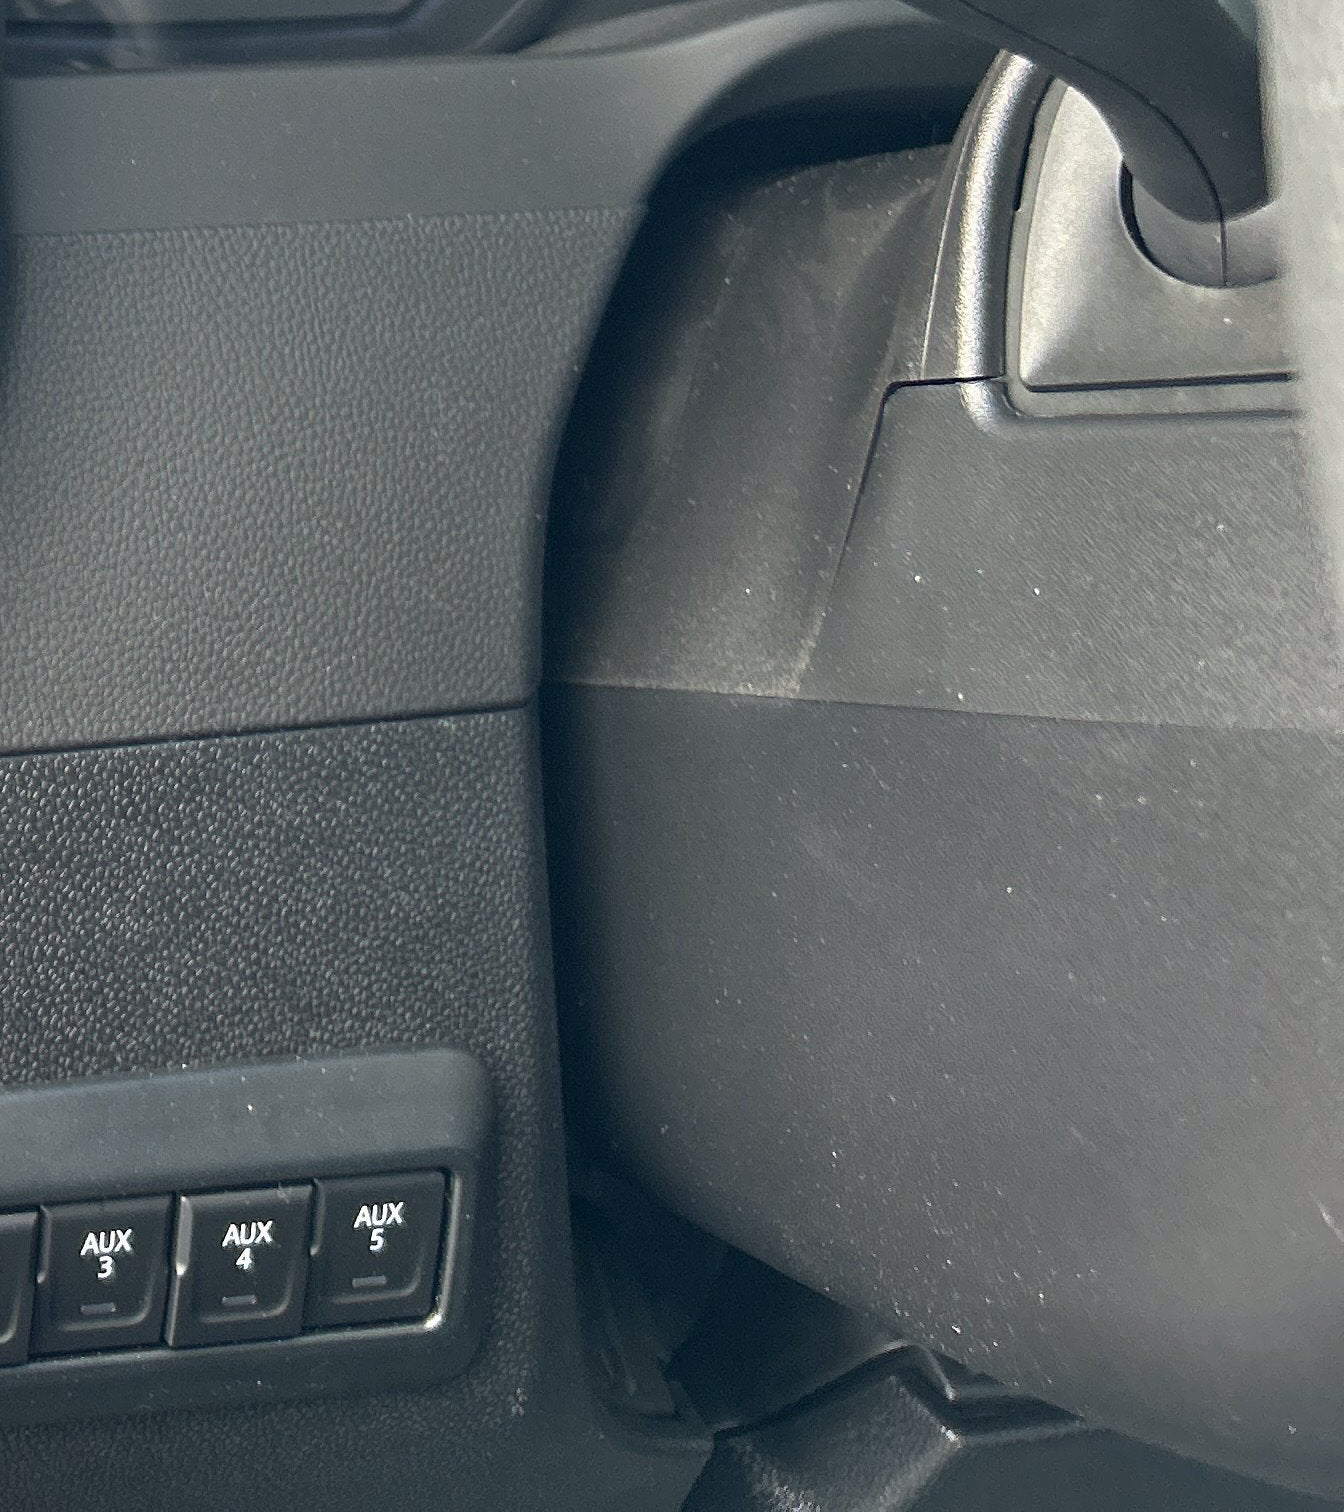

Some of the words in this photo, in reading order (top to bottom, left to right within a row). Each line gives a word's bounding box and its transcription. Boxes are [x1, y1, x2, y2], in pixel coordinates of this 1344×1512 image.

[352, 1200, 405, 1230] AUX
[79, 1227, 134, 1257] AUX
[220, 1219, 274, 1249] AUX
[368, 1227, 386, 1253] 5
[96, 1255, 116, 1280] 3
[234, 1246, 254, 1271] 4
